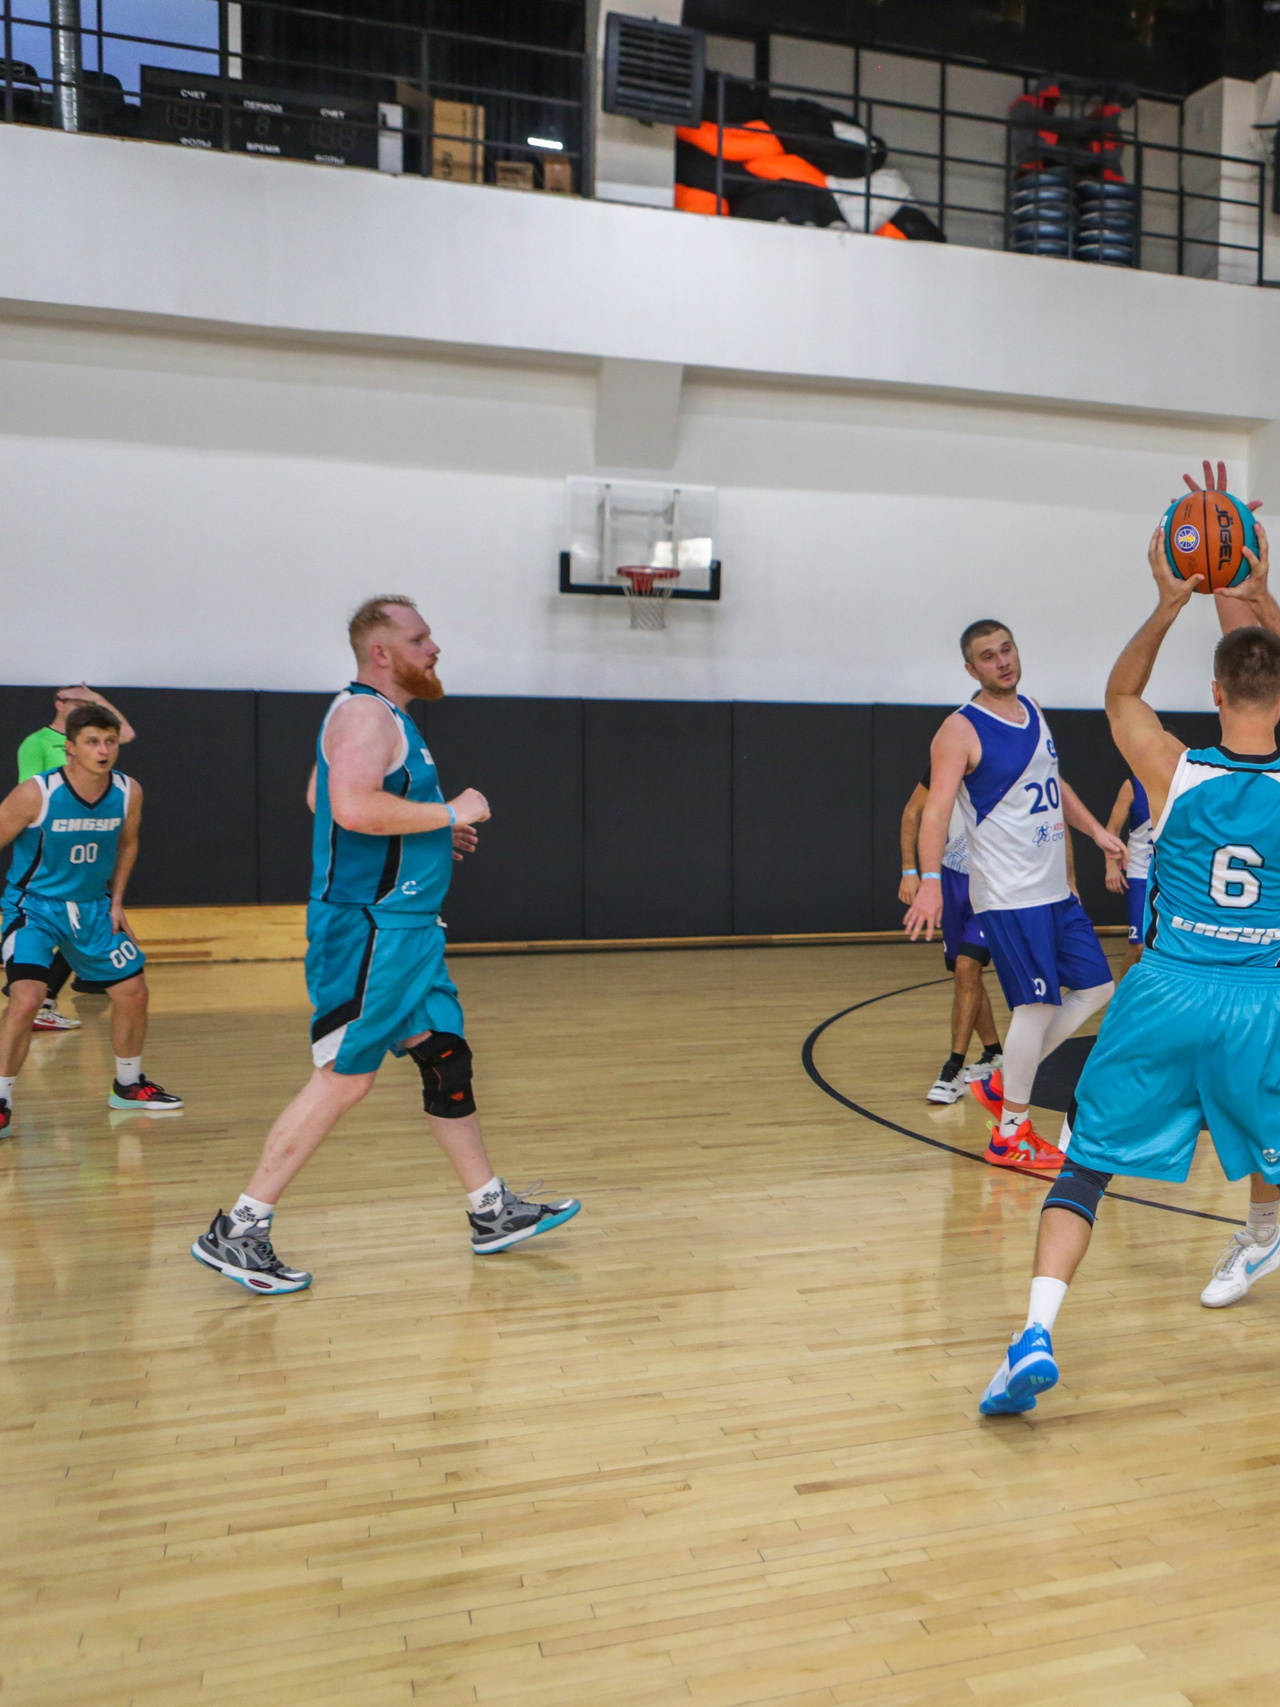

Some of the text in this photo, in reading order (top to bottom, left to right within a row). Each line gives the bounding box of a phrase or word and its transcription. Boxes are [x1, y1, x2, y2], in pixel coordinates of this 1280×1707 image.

[1213, 503, 1234, 571] JÖGEL
[1024, 777, 1060, 815] 20
[51, 817, 122, 832] СИБУР
[69, 843, 99, 864] 00
[1208, 843, 1265, 909] 6
[109, 940, 138, 969] 00
